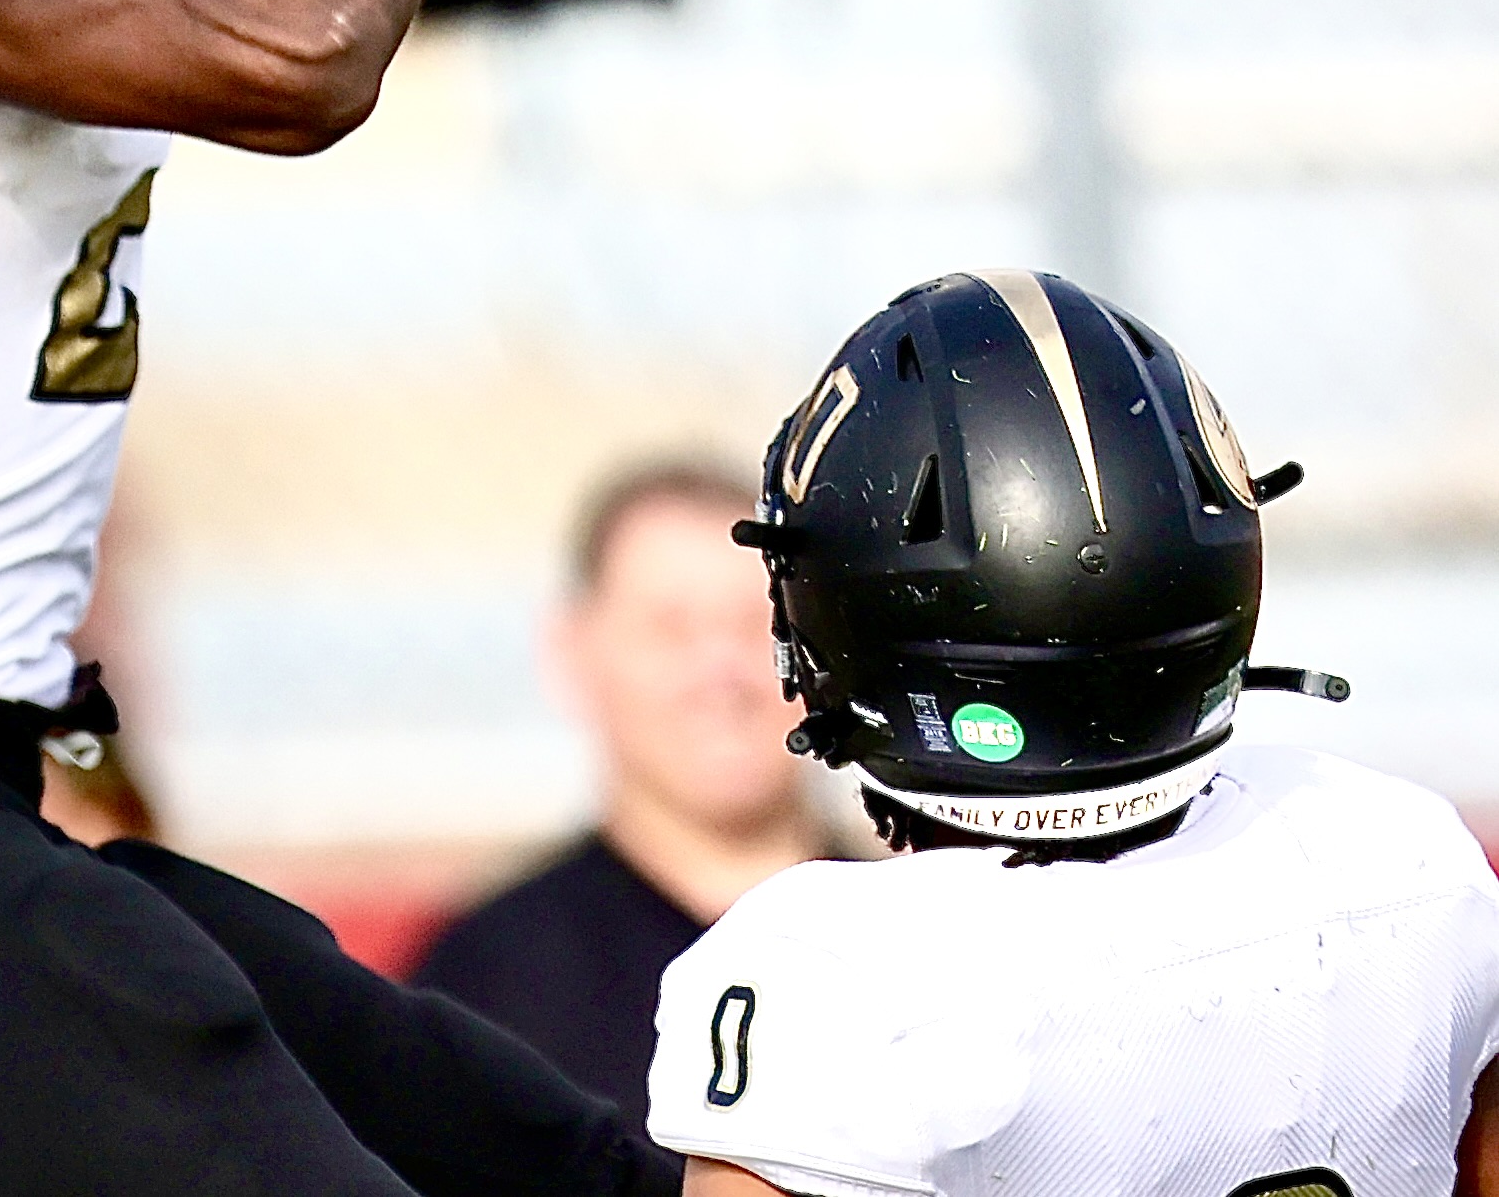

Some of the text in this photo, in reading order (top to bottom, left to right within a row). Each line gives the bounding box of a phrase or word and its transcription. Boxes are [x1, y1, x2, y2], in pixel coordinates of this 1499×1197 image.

[915, 801, 1004, 828] FAMILY
[1014, 807, 1086, 831] OVER
[704, 980, 762, 1114] 0
